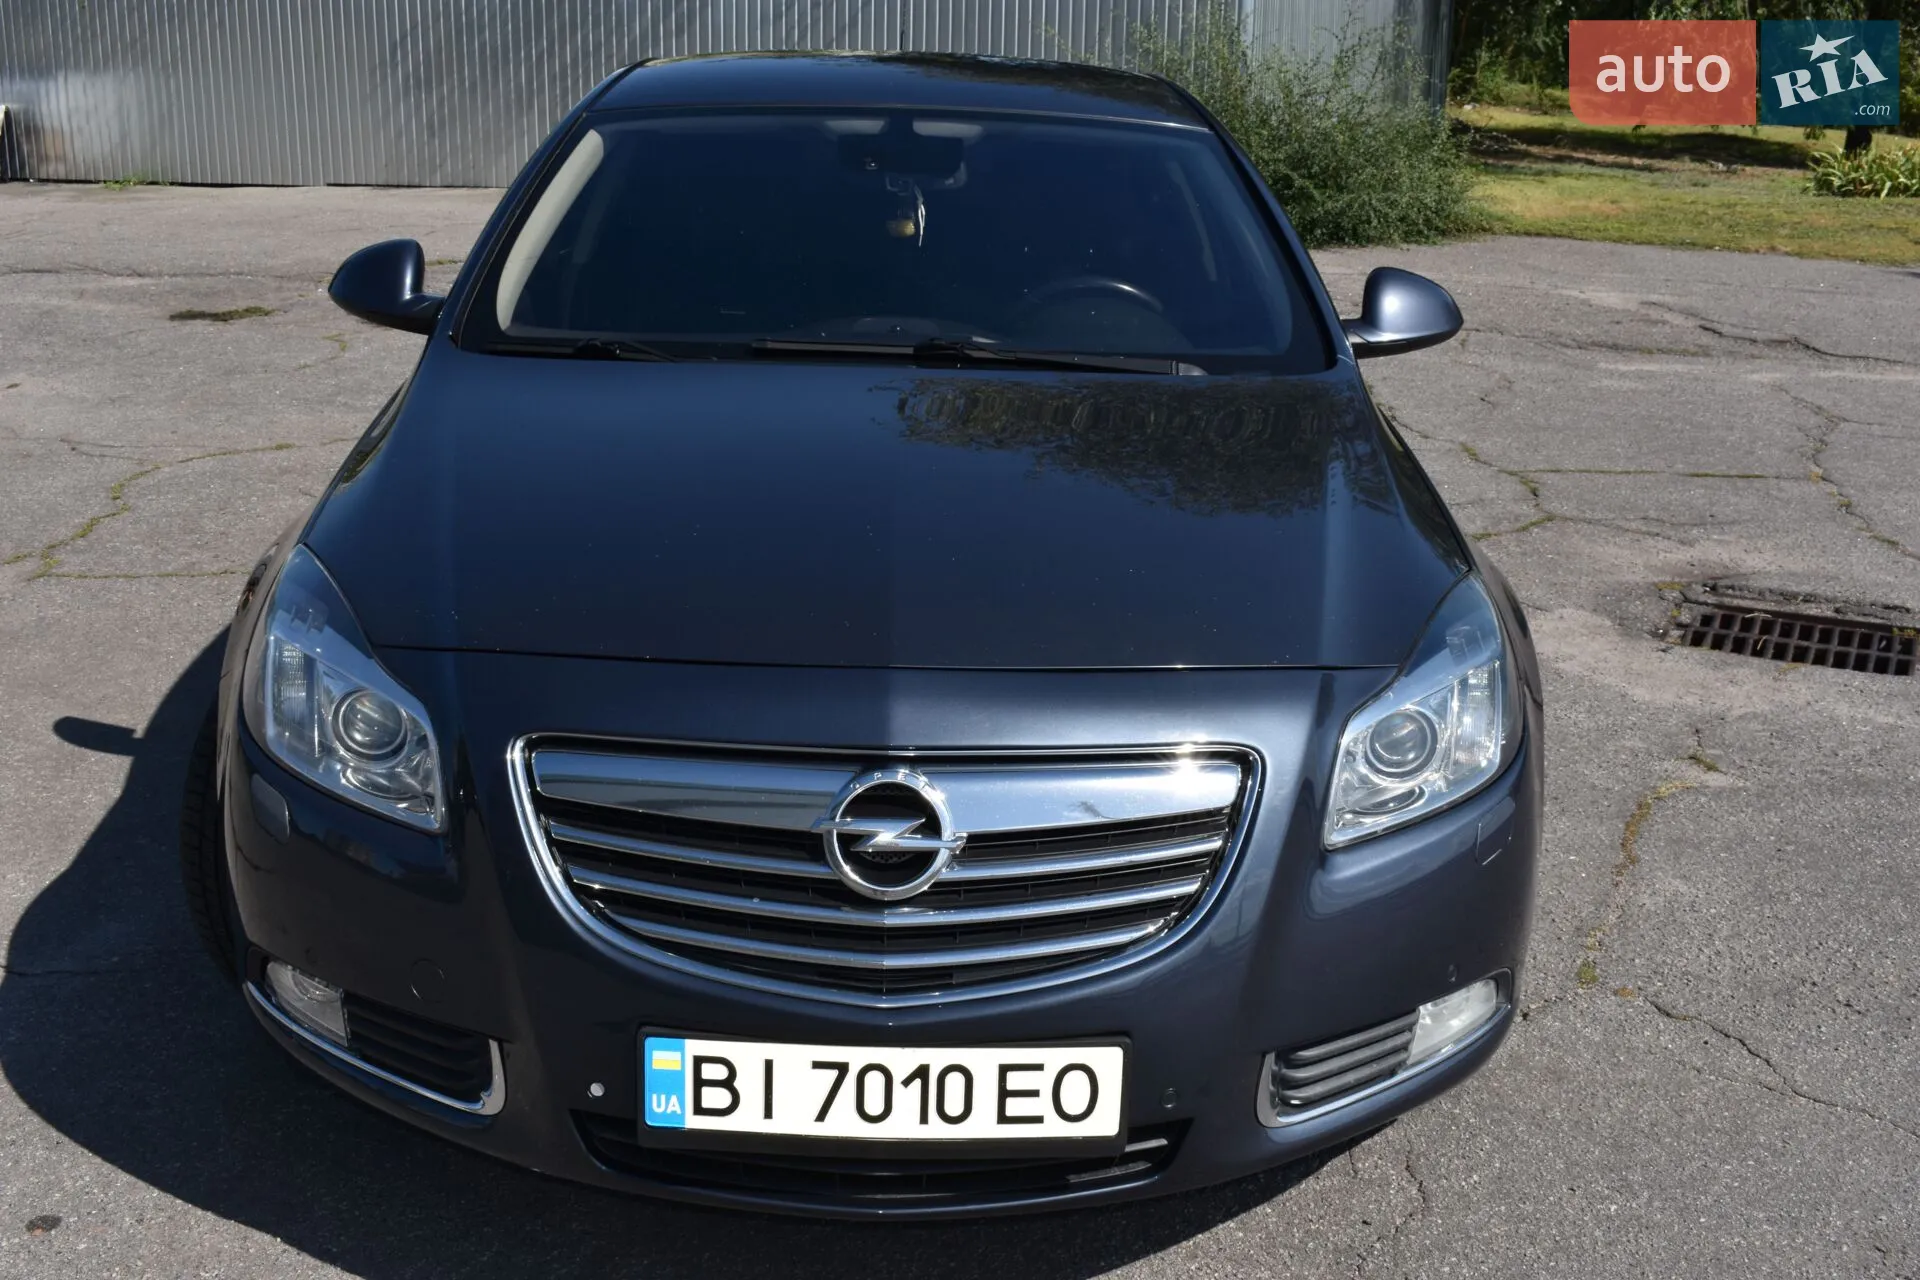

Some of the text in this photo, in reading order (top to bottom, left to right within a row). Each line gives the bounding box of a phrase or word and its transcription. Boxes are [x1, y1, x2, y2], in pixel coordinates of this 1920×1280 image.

[652, 1094, 682, 1114] UA
[810, 1060, 974, 1125] 7010
[996, 1062, 1100, 1125] EO
